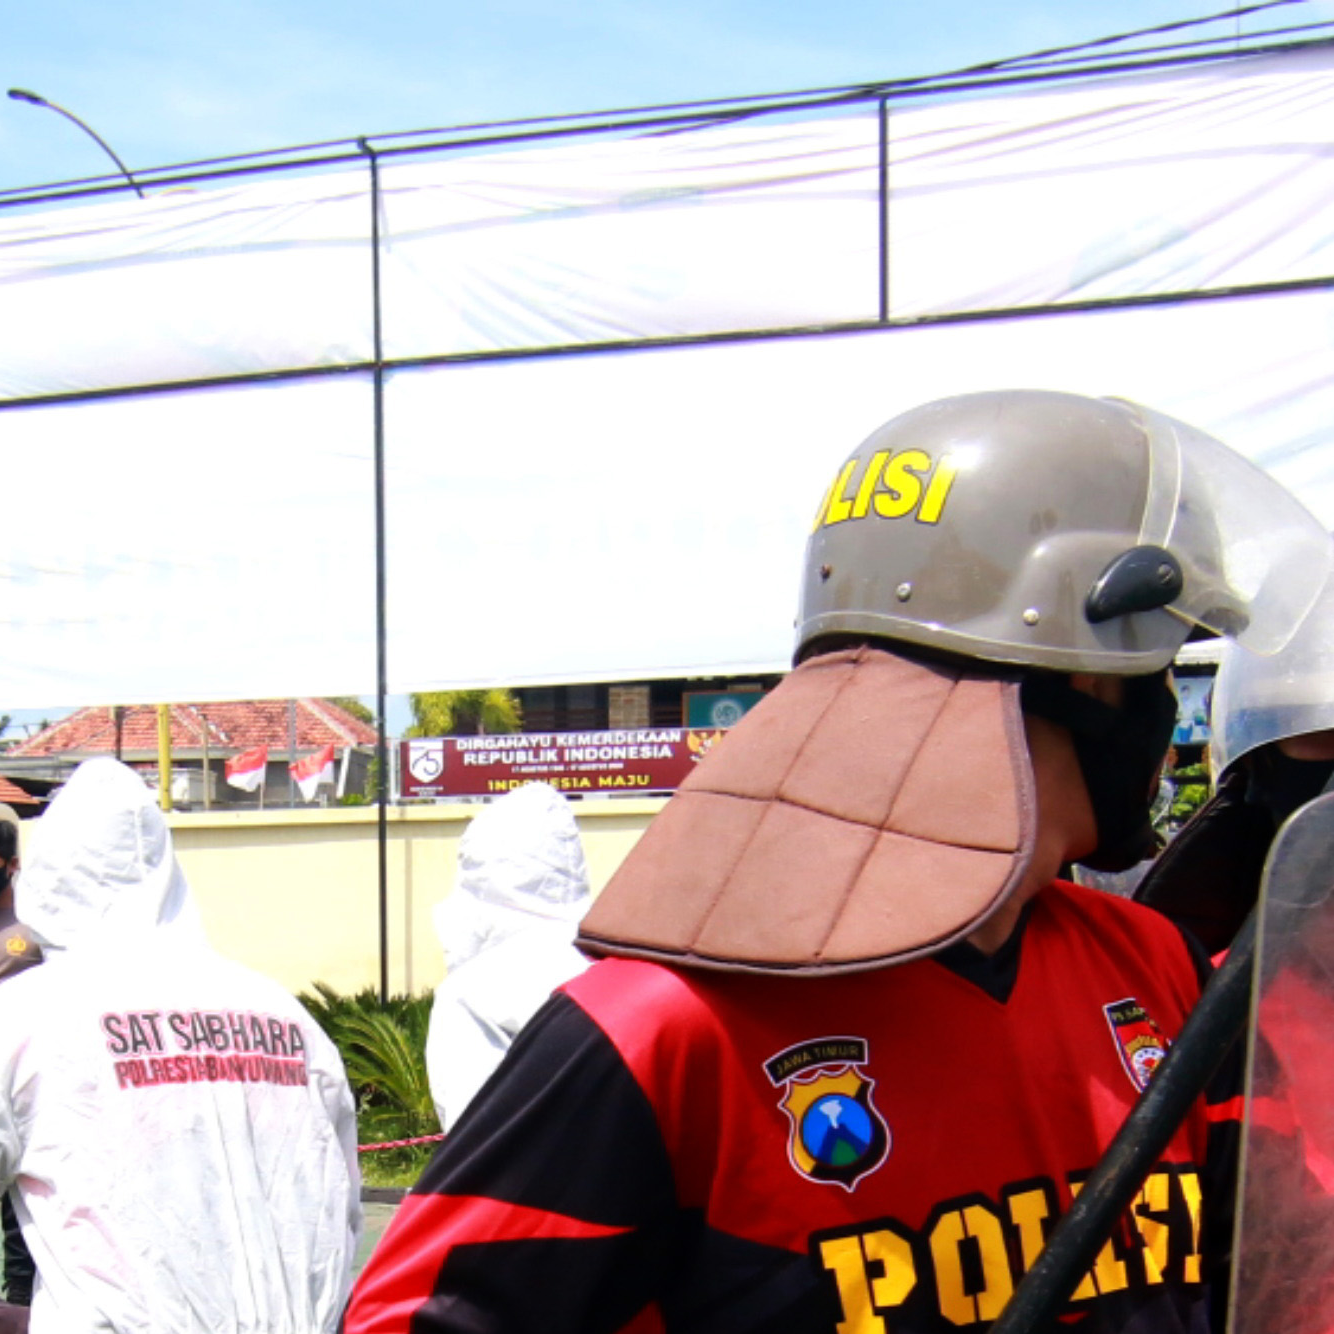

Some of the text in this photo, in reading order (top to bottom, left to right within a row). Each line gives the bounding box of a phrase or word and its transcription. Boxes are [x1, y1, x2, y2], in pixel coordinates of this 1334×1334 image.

[811, 449, 958, 534] LISI
[456, 731, 681, 750] DIRGAHAYU KEMERDEKAAN
[463, 744, 673, 766] REPUBLIK INDONESIA
[487, 775, 651, 792] INDESIA MAJU
[102, 1012, 305, 1057] SAT SABHARA
[776, 1050, 812, 1076] JAWA
